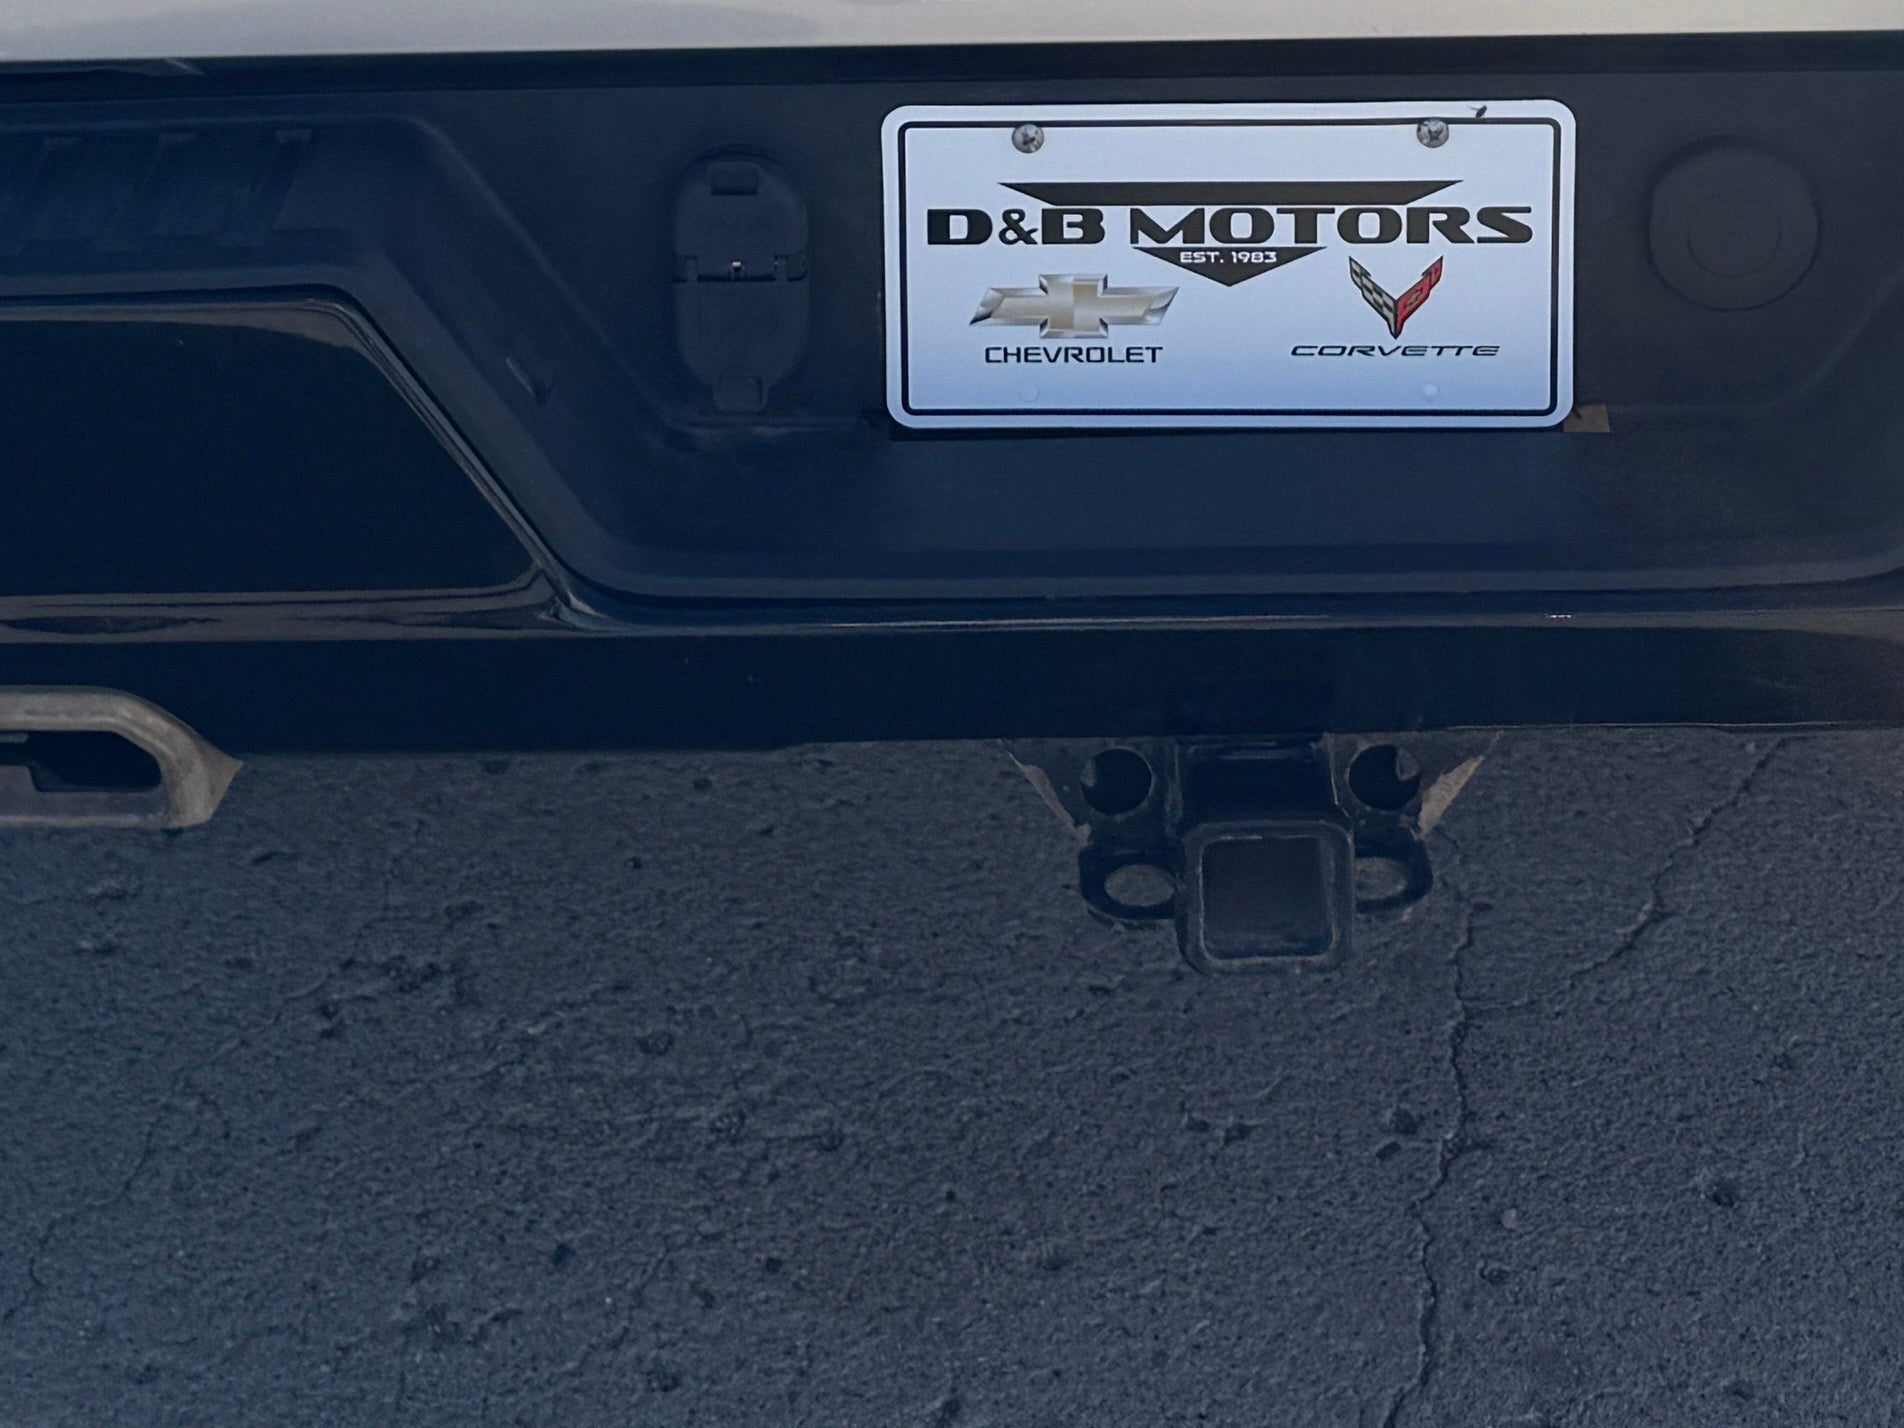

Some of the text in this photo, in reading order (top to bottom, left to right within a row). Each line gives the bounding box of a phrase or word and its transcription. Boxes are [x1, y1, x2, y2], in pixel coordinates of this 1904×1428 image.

[926, 205, 1534, 245] D&B MOTORS
[1179, 250, 1278, 264] EST. 1983
[984, 345, 1164, 364] CHEVROLET
[1290, 344, 1501, 357] CORVETTE
